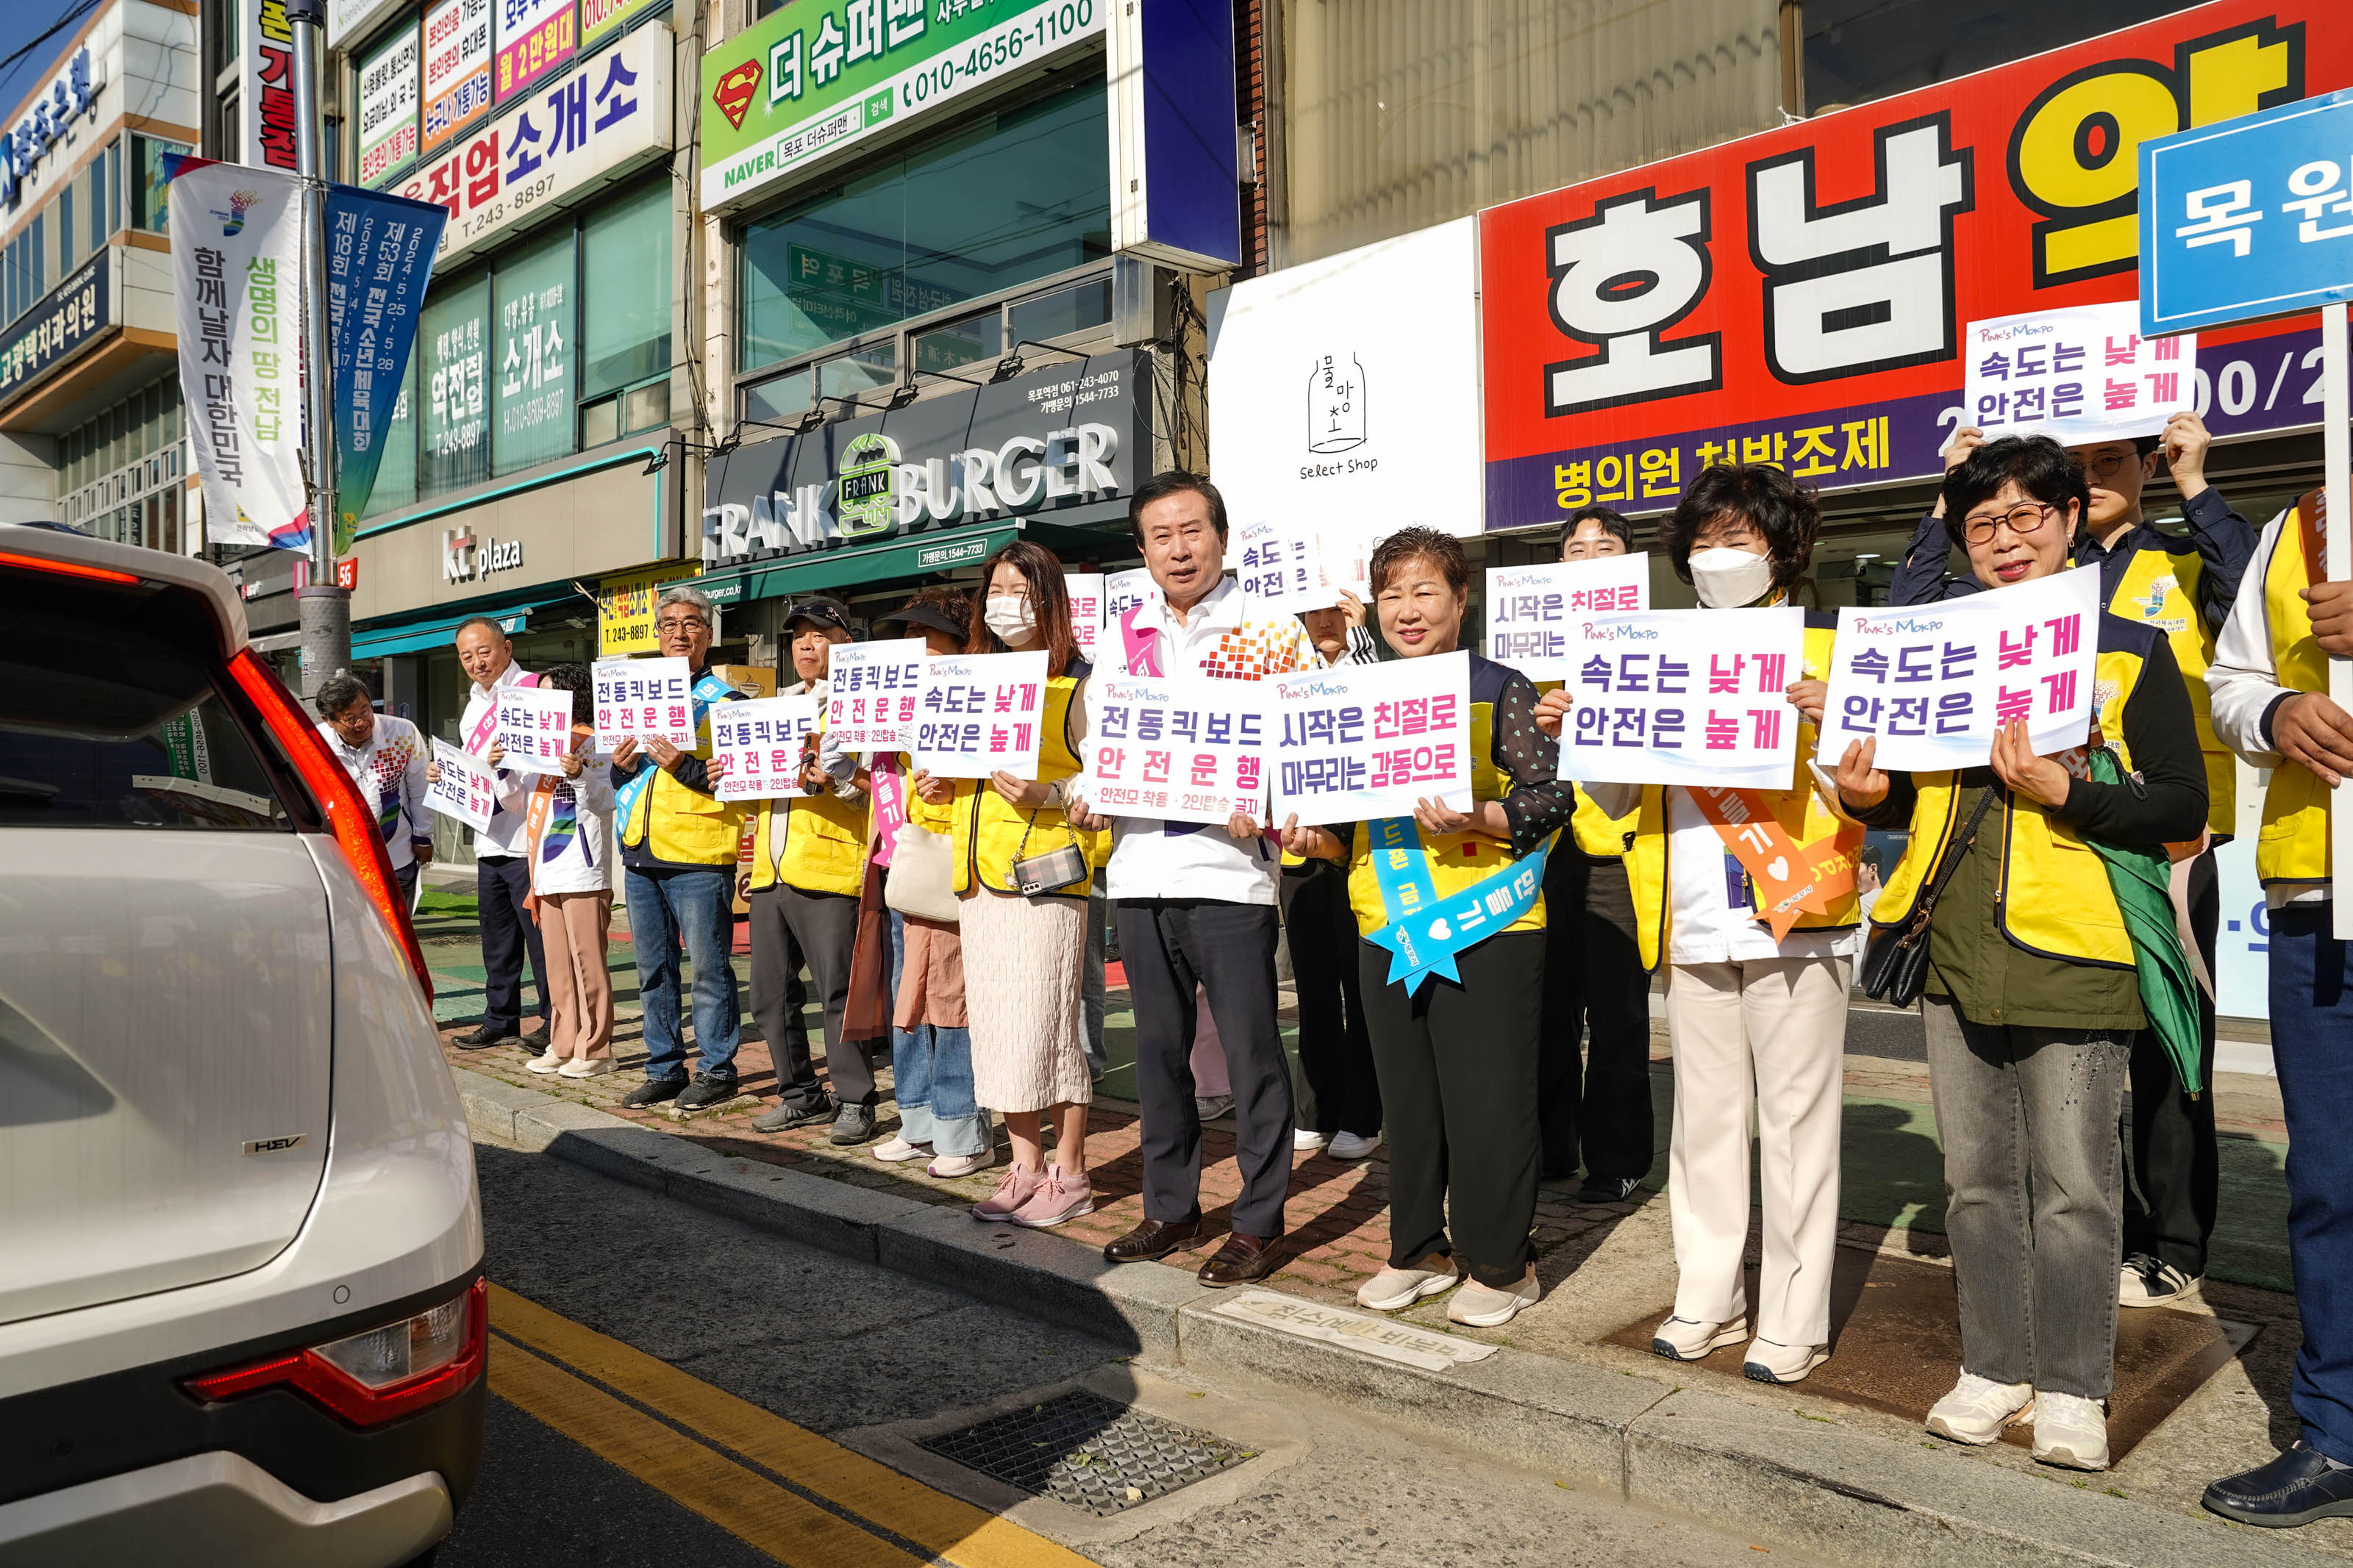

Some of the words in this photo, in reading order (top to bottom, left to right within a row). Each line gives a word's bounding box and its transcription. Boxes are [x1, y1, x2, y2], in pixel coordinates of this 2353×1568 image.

[429, 7, 459, 49] 본인인증
[429, 43, 460, 86] 본인명의
[462, 23, 487, 61] 휴대폰
[916, 0, 1093, 101] 010-4656-1100
[500, 51, 513, 93] 월
[426, 94, 452, 139] 누구나
[453, 71, 488, 121] 개통가능
[870, 96, 888, 118] 검색
[389, 122, 415, 168] 개통가능
[783, 137, 803, 159] 목포
[807, 114, 848, 148] 더슈퍼맨
[724, 150, 775, 189] NAVER
[331, 211, 357, 277] 제18회
[373, 221, 407, 282] 제53회
[245, 256, 278, 345] 생명의
[251, 351, 282, 380] 땅
[501, 319, 565, 398] 소개소
[1979, 342, 2085, 382] 속도는
[1027, 382, 1060, 403] 목포역점
[1060, 370, 1119, 393] 061-243-4070
[1040, 395, 1072, 415] 가맹문의
[1075, 385, 1119, 406] 1544-7733
[1977, 382, 2084, 427] 안전은
[2104, 372, 2178, 412] 높게
[253, 386, 282, 442] 전남
[899, 423, 1118, 526] BURGER
[1348, 457, 1379, 473] Shop
[1553, 446, 1681, 509] 병의원
[844, 472, 887, 500] FRANK
[701, 480, 843, 561] FRANK
[339, 564, 351, 587] 5G
[479, 537, 521, 581] plaza
[1495, 593, 1563, 624] 시작은
[1495, 631, 1565, 659] 마무리는
[1850, 641, 1977, 684] 속도는
[1998, 613, 2082, 671] 낮게
[597, 678, 685, 704] 전동킥보드
[832, 663, 920, 693] 전동킥보드
[1580, 654, 1690, 694] 속도는
[1708, 654, 1786, 694] 낮게
[500, 706, 534, 729] 속도는
[539, 709, 566, 731] 낮게
[924, 685, 986, 714] 속도는
[993, 683, 1038, 713] 낮게
[1840, 692, 1974, 736] 안전은
[1996, 669, 2077, 726] 높게
[670, 732, 689, 744] 금지
[716, 717, 813, 748] 전동킥보드
[833, 730, 852, 744] 안전모
[853, 729, 865, 743] 착용
[917, 723, 980, 753] 안전은
[989, 723, 1032, 753] 높게
[1100, 705, 1263, 746] 전동킥보드
[1279, 706, 1365, 748] 시작은
[1374, 693, 1457, 740] 친절로
[1574, 706, 1685, 749] 안전은
[1704, 709, 1781, 750] 높게
[499, 732, 534, 756] 안전은
[539, 736, 565, 758] 높게
[435, 756, 466, 784] 속도는
[470, 770, 491, 795] 낮게
[724, 780, 747, 793] 안전모
[747, 779, 763, 792] 착용
[1281, 756, 1366, 796] 마무리는
[1370, 742, 1457, 789] 감동으로
[432, 778, 466, 807] 안전은
[470, 793, 491, 818] 높게
[874, 761, 901, 825] 만들기
[1099, 787, 1139, 806] 안전모
[1142, 790, 1169, 808] 착용
[1180, 792, 1230, 813] 2인탑승
[254, 1136, 301, 1153] HEV
